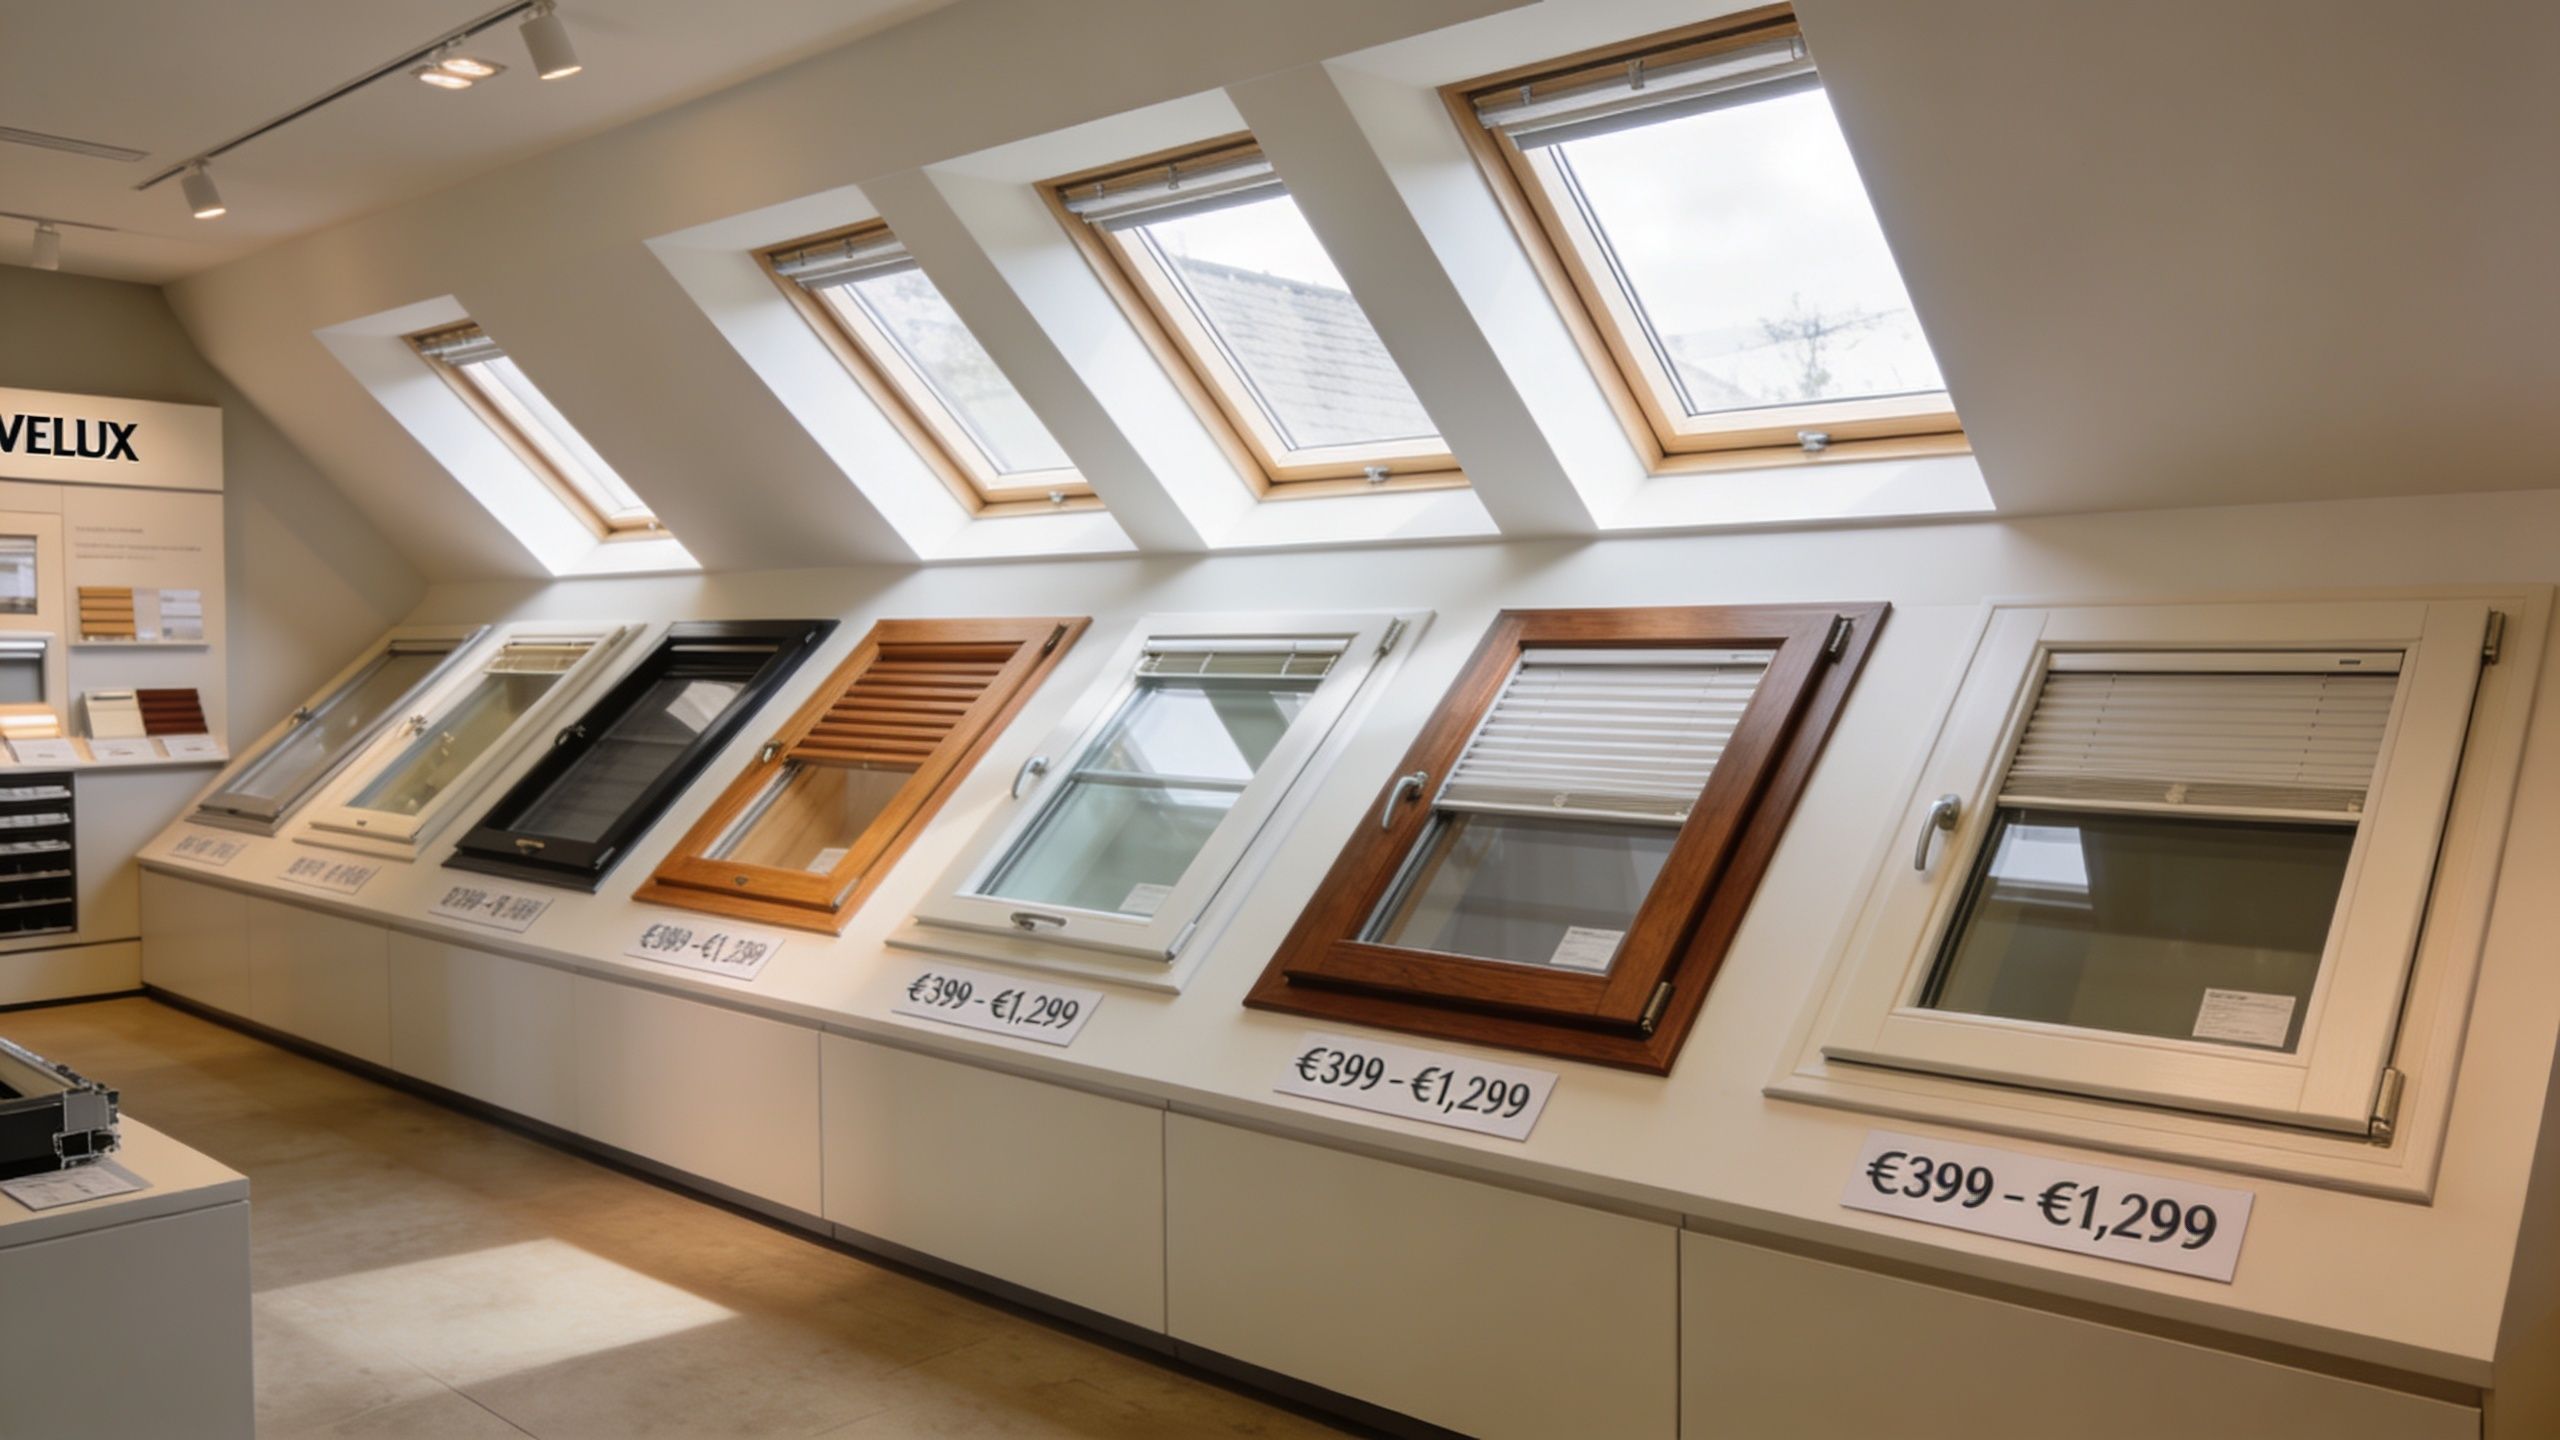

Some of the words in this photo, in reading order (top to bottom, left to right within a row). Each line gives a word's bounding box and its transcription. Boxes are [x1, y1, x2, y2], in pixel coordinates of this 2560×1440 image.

[0, 413, 139, 462] VELUX
[907, 973, 972, 1009] €399
[1295, 1047, 1384, 1090] €399
[1410, 1067, 1530, 1118] €1,299
[1866, 1151, 1994, 1208] €399
[2037, 1181, 2217, 1250] €1,299
